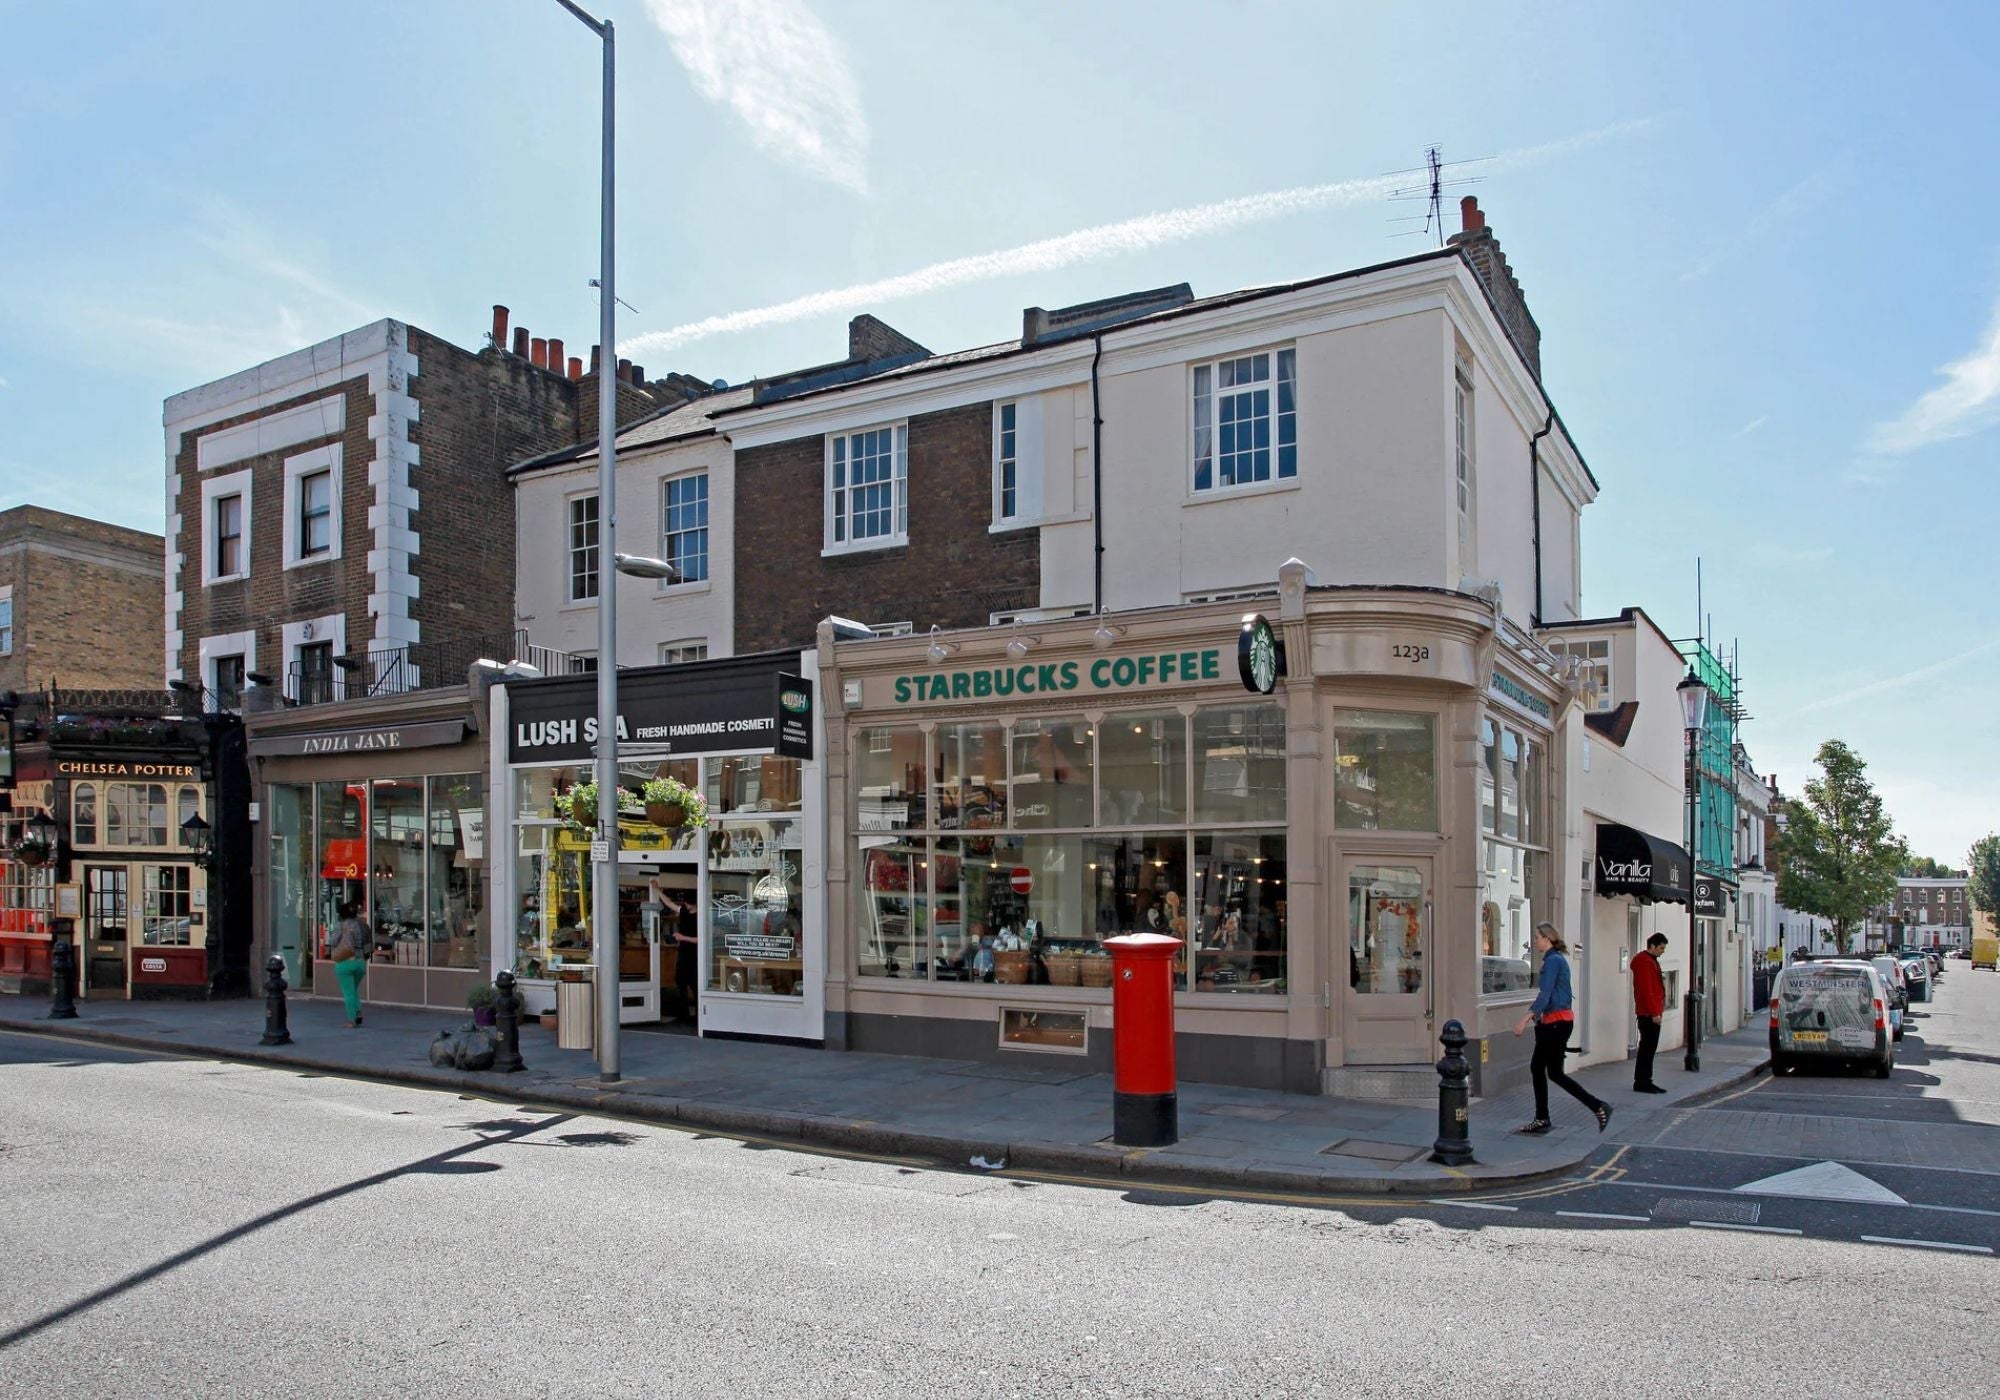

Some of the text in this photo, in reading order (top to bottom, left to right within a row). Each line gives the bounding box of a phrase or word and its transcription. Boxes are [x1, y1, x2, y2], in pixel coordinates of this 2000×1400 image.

[1392, 645, 1429, 663] 123a
[894, 649, 1220, 703] STARBUCKS COFFEE
[783, 693, 807, 708] LUSH
[518, 715, 629, 747] LUSH SA
[636, 717, 775, 739] FRESH HANDMADE COSMETI
[303, 731, 400, 753] INDIA JANE
[59, 762, 194, 776] CHELSEA POTTER
[1599, 856, 1653, 878] Vanilla
[1695, 898, 1715, 908] xfam
[1789, 980, 1864, 988] WESTMINSTER
